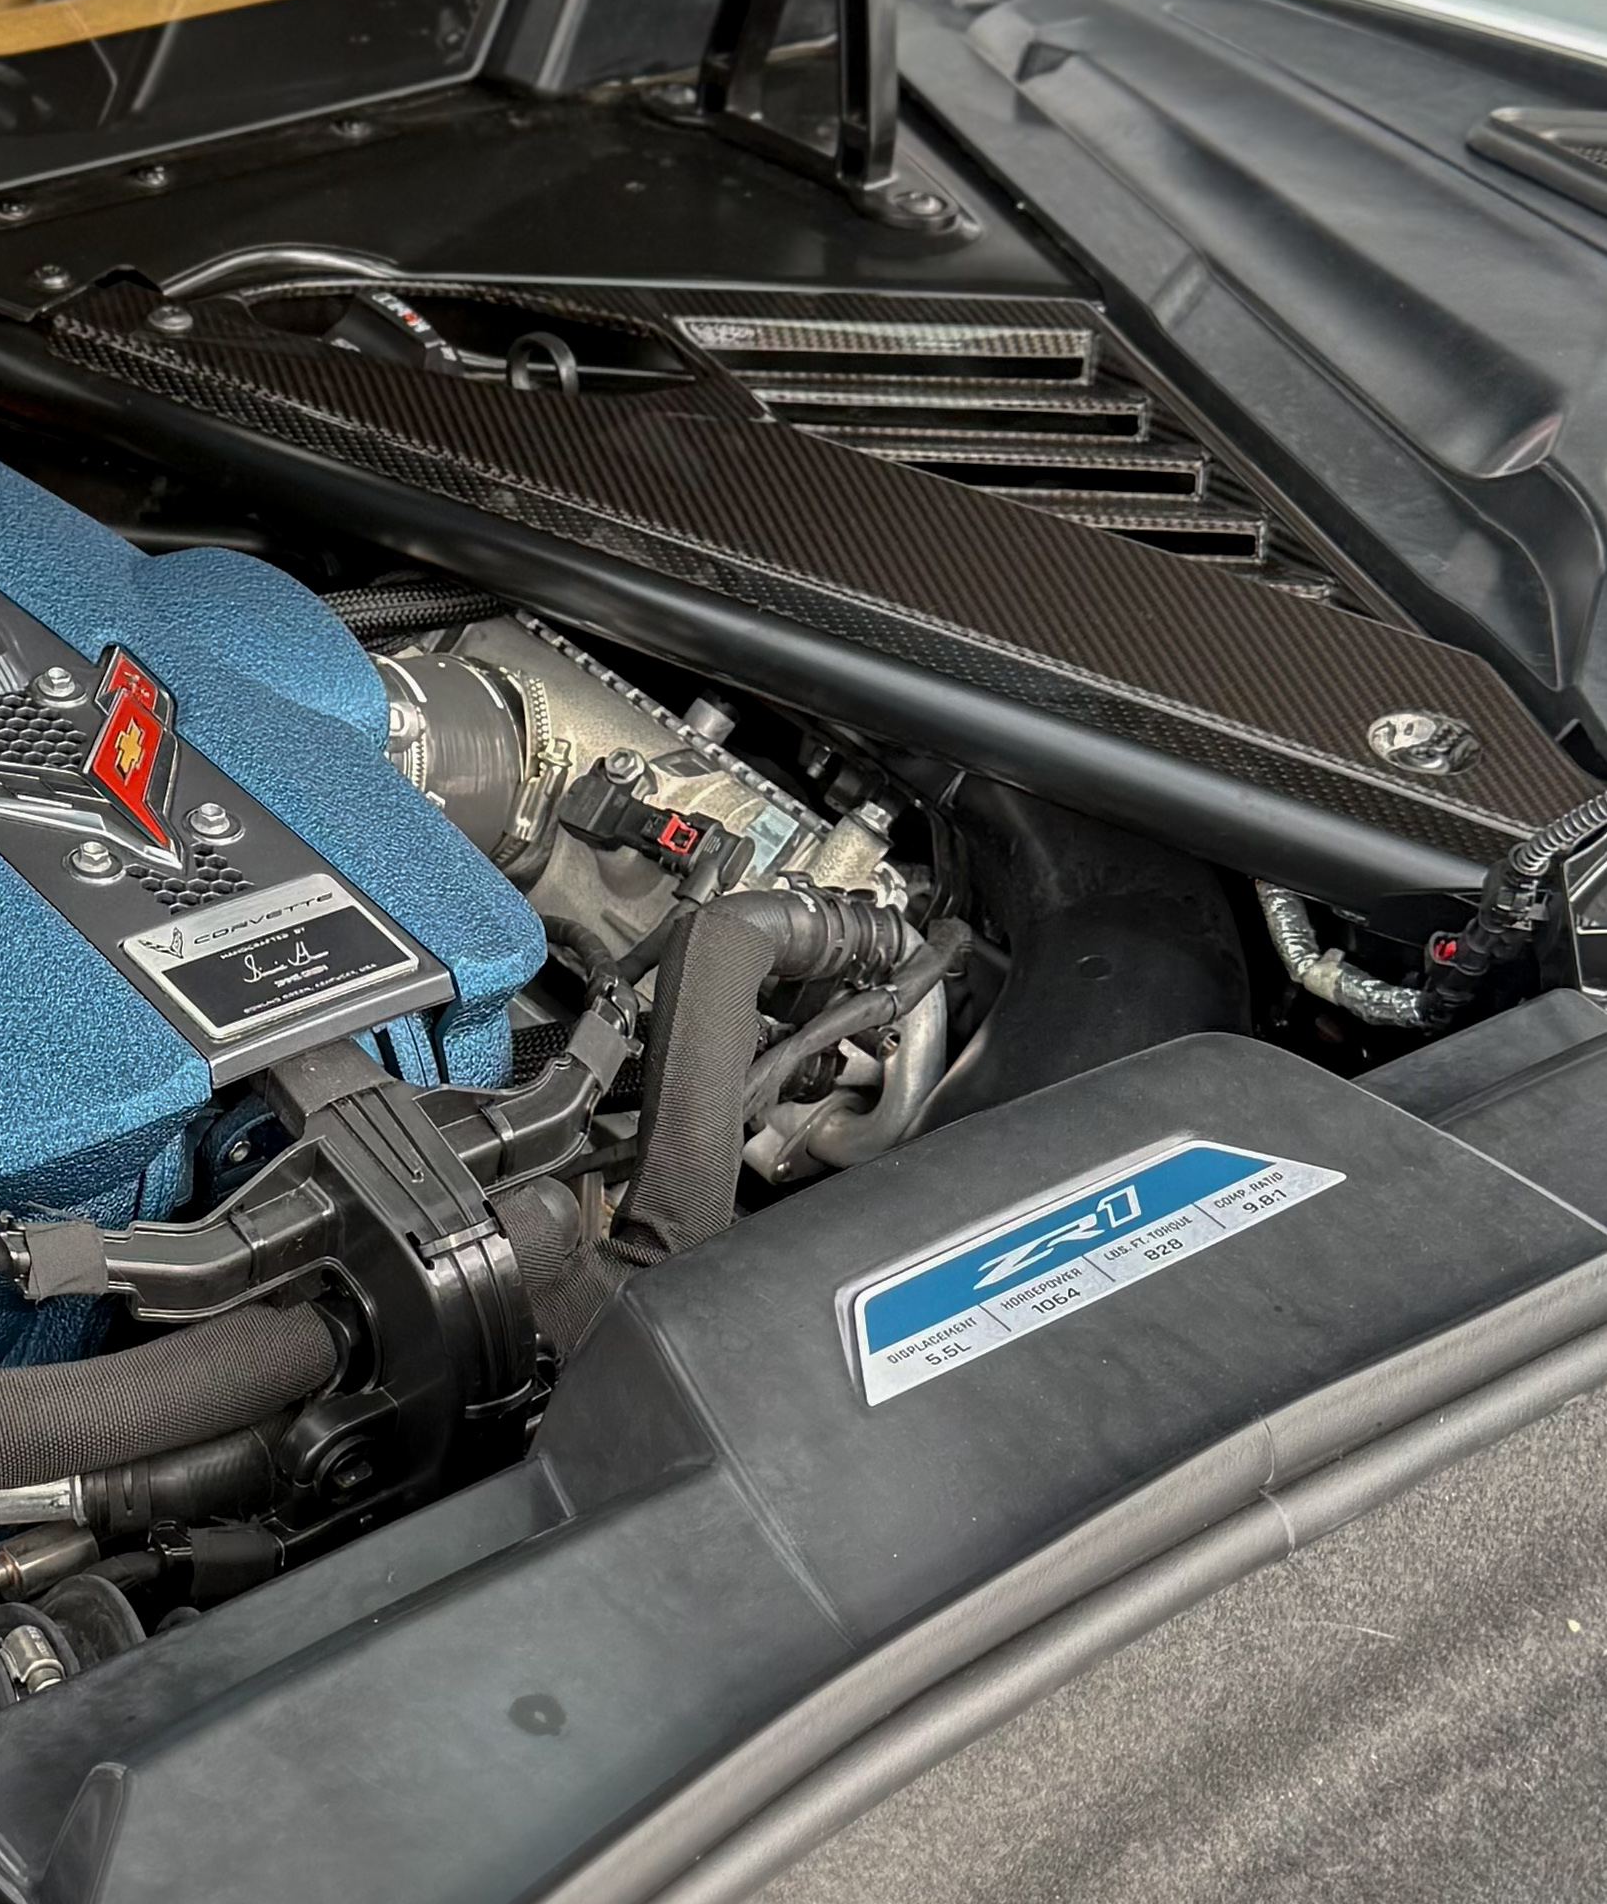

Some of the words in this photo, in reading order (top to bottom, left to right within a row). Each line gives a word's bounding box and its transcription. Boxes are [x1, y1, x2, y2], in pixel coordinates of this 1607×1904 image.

[193, 891, 334, 946] CORVETTE
[972, 1183, 1143, 1291] ZR1
[1151, 1214, 1193, 1244] TORQUE
[1144, 1237, 1184, 1263] 828
[1030, 1286, 1082, 1316] 1064
[924, 1340, 973, 1367] 5.5L
